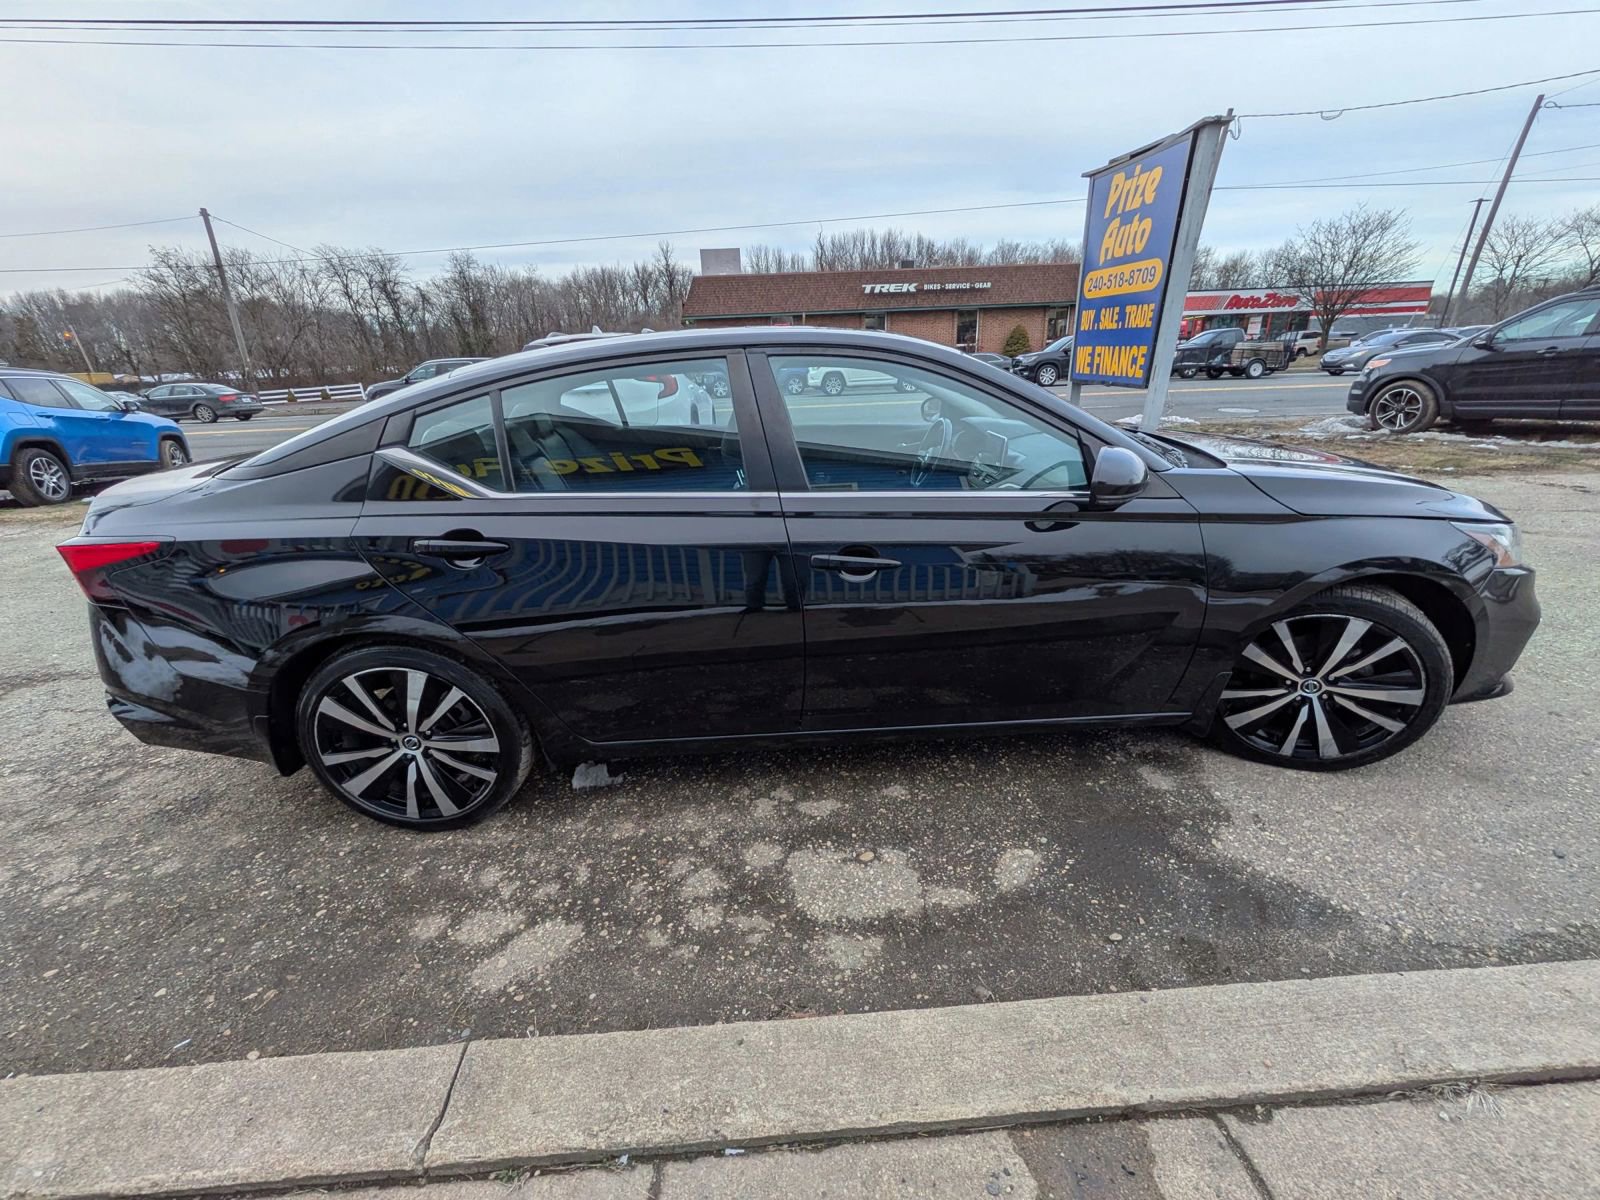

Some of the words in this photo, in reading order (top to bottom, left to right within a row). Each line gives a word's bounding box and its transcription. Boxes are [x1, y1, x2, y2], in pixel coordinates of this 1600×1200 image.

[1103, 164, 1163, 219] Prize
[1099, 212, 1152, 266] Auto
[862, 282, 919, 294] TREK
[975, 281, 992, 289] GEAR
[1087, 265, 1157, 293] 240-518-8709
[1223, 293, 1302, 310] AutoZone
[1080, 309, 1096, 331] BUY
[1100, 306, 1120, 330] SALE
[1125, 303, 1155, 328] TRADE
[1075, 345, 1093, 374] WE
[1093, 345, 1148, 378] FINANCE
